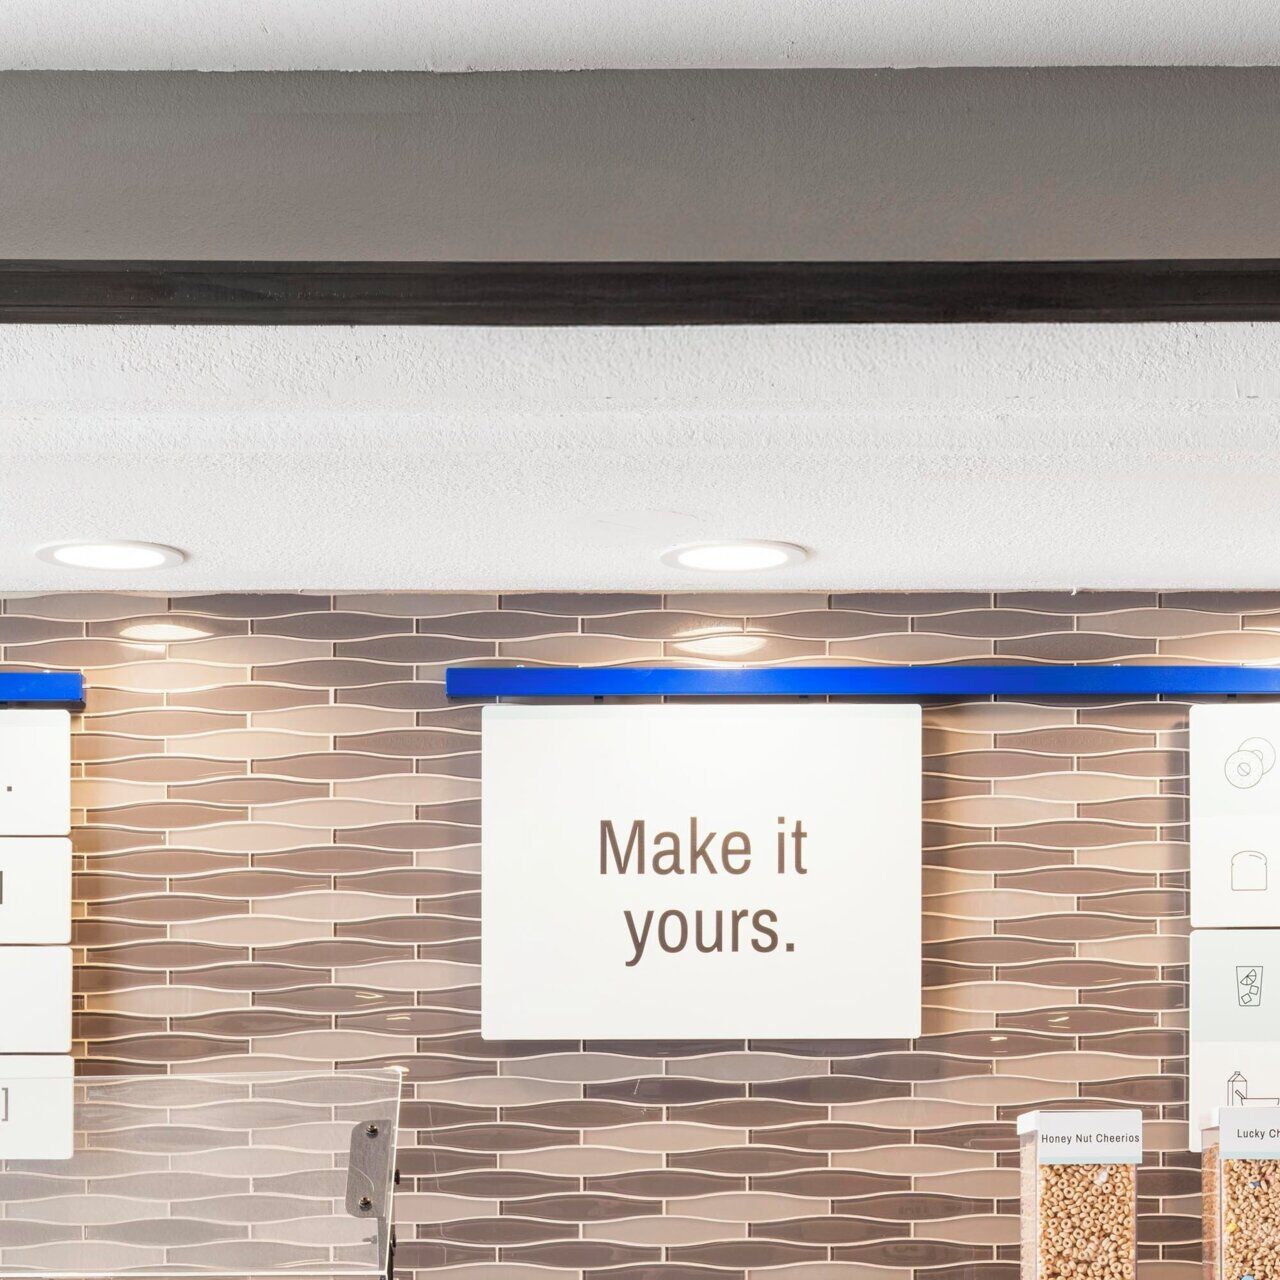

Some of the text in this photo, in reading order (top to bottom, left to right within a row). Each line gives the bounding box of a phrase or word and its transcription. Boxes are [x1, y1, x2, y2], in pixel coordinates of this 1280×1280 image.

[599, 816, 808, 876] Make it
[623, 908, 795, 968] yours.
[1041, 1132, 1140, 1145] Honey Nut Cheerios
[1237, 1128, 1266, 1141] Lucky
